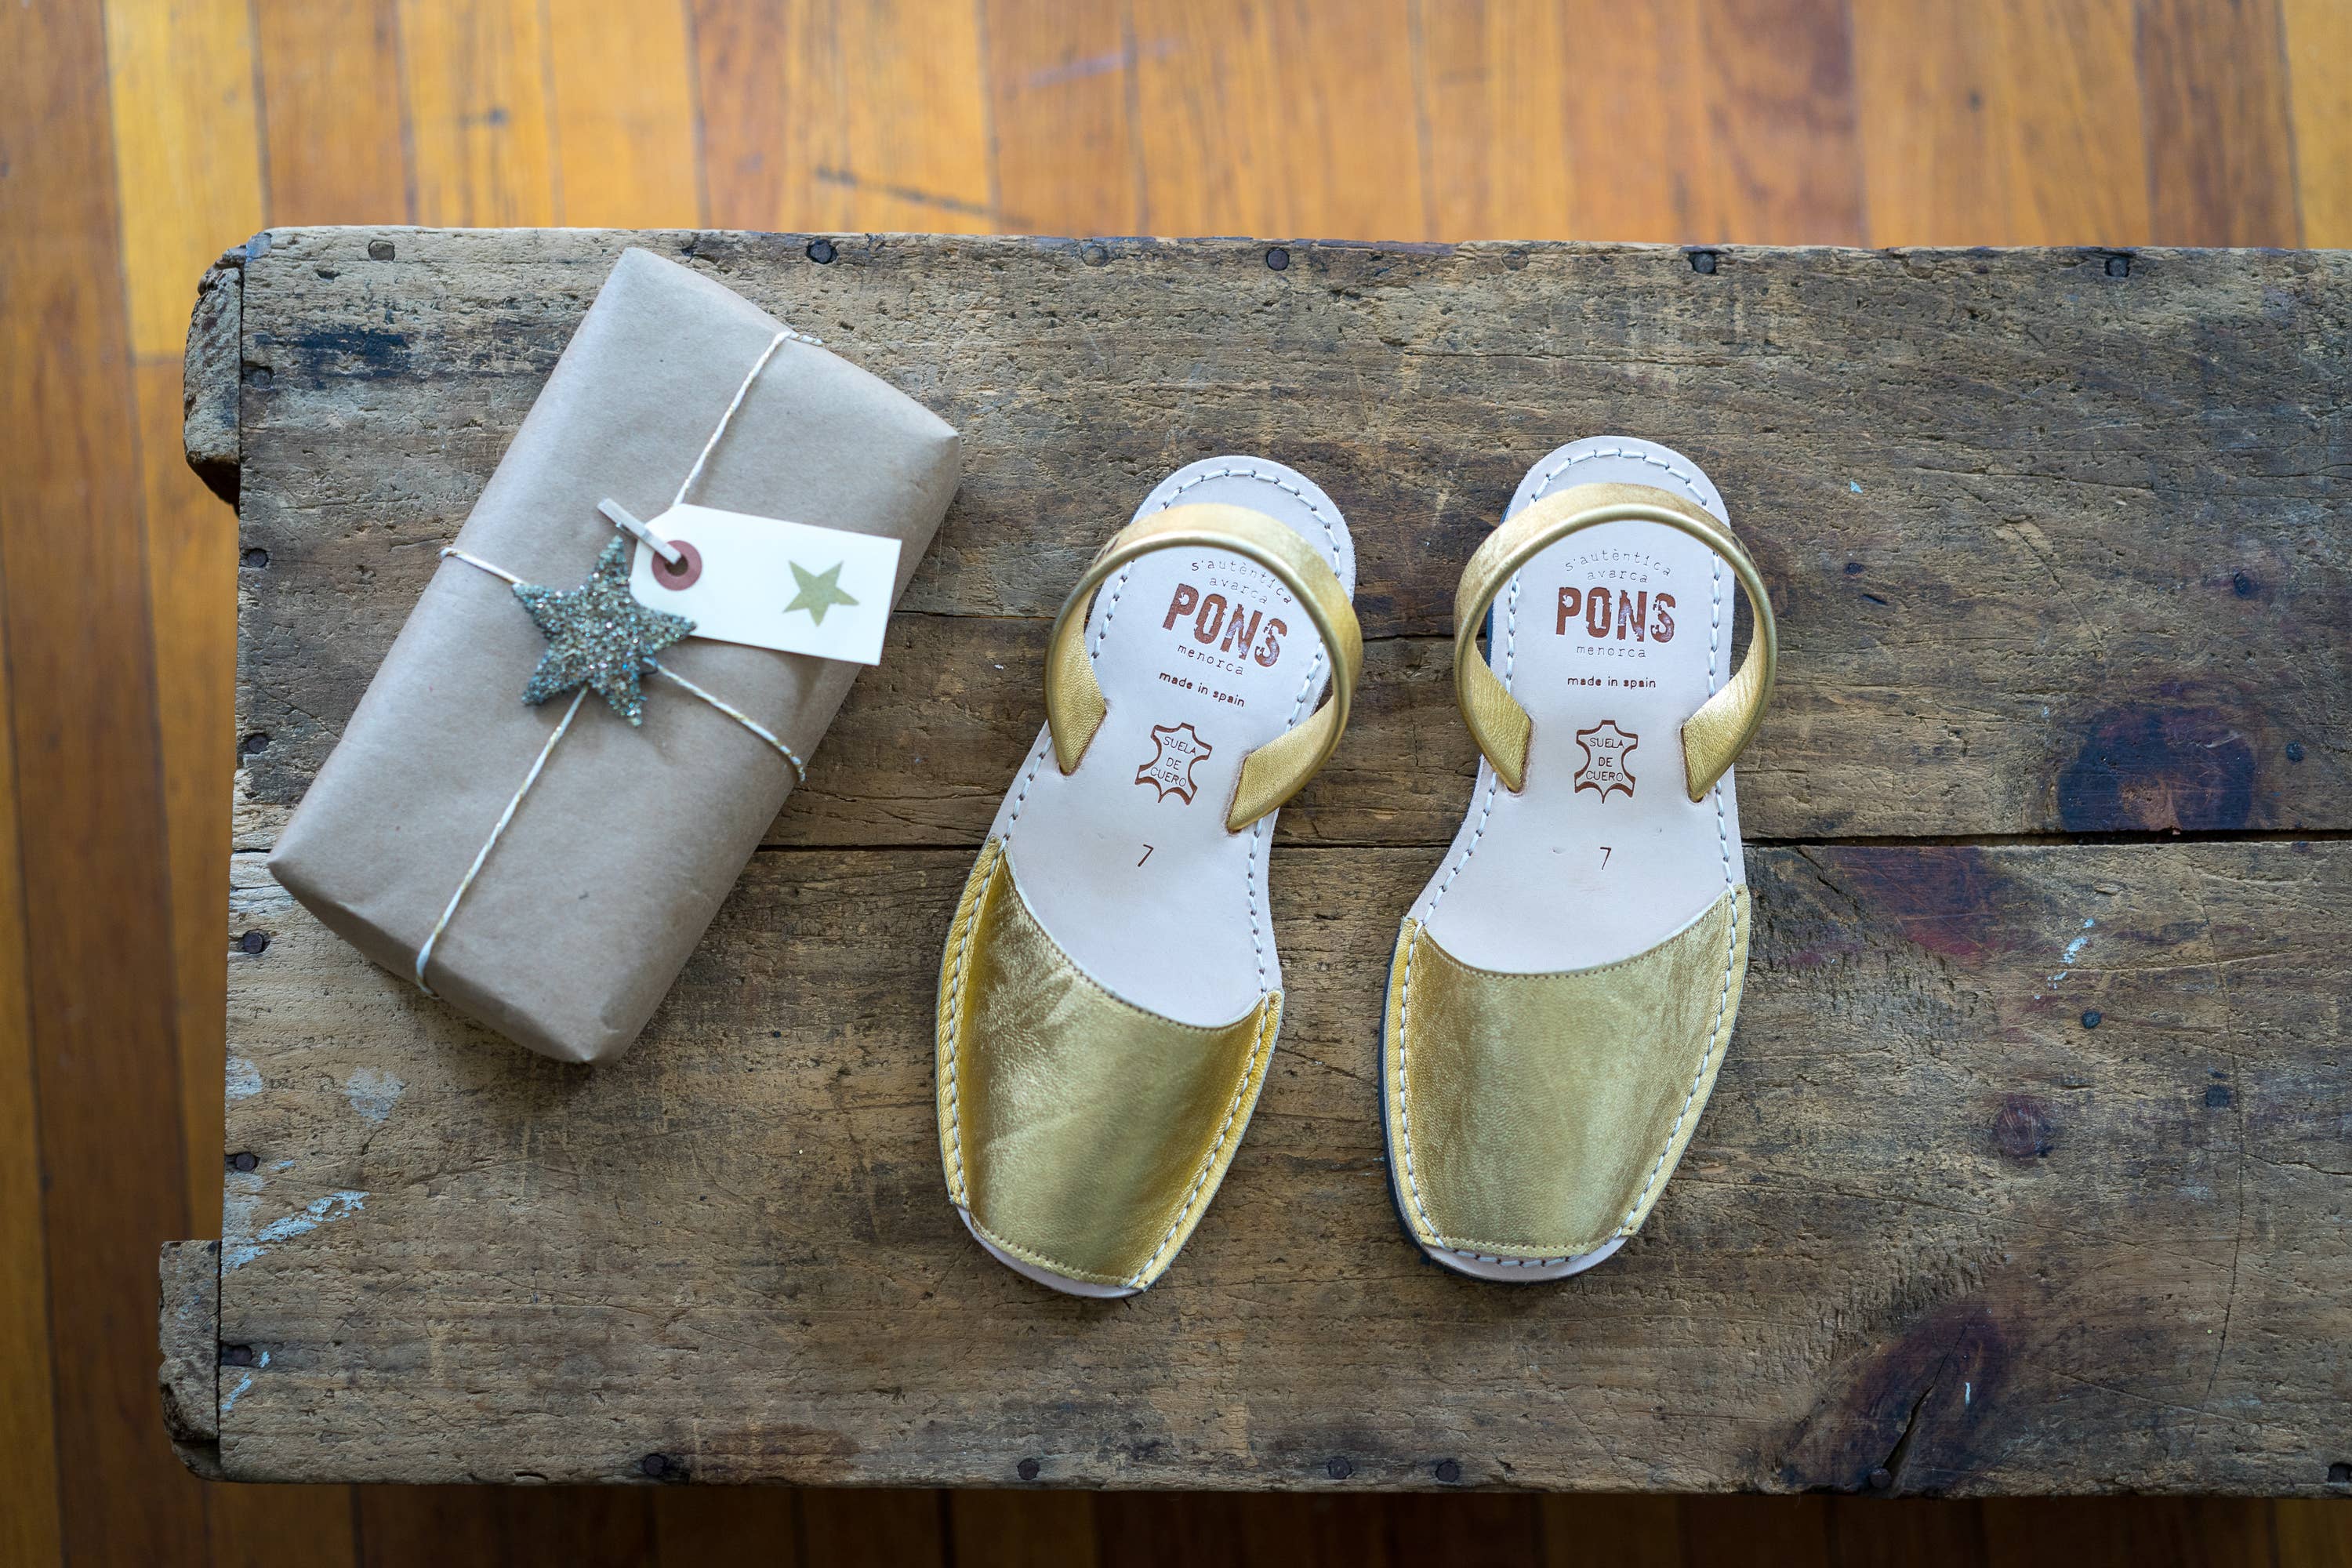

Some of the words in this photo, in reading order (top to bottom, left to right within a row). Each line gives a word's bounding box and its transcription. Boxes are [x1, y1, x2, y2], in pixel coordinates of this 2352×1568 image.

[1587, 569, 1648, 583] avarca
[1209, 577, 1268, 604] avarca
[1556, 586, 1676, 643] PONS
[1163, 583, 1287, 667] PONS
[1178, 645, 1243, 675] menorca
[1577, 646, 1646, 658] menorca
[1160, 672, 1193, 691] made
[1198, 682, 1208, 694] in
[1213, 691, 1245, 707] spain
[1568, 677, 1601, 687] made
[1608, 677, 1618, 687] in
[1624, 677, 1656, 688] spain
[1163, 736, 1198, 756] SUELA
[1590, 738, 1624, 748] SUELA
[1166, 757, 1181, 771] DE
[1599, 757, 1613, 767] DE
[1150, 768, 1187, 787] CUERO
[1586, 771, 1624, 782] CUERO
[1137, 844, 1153, 867] 7
[1600, 848, 1612, 870] 7
